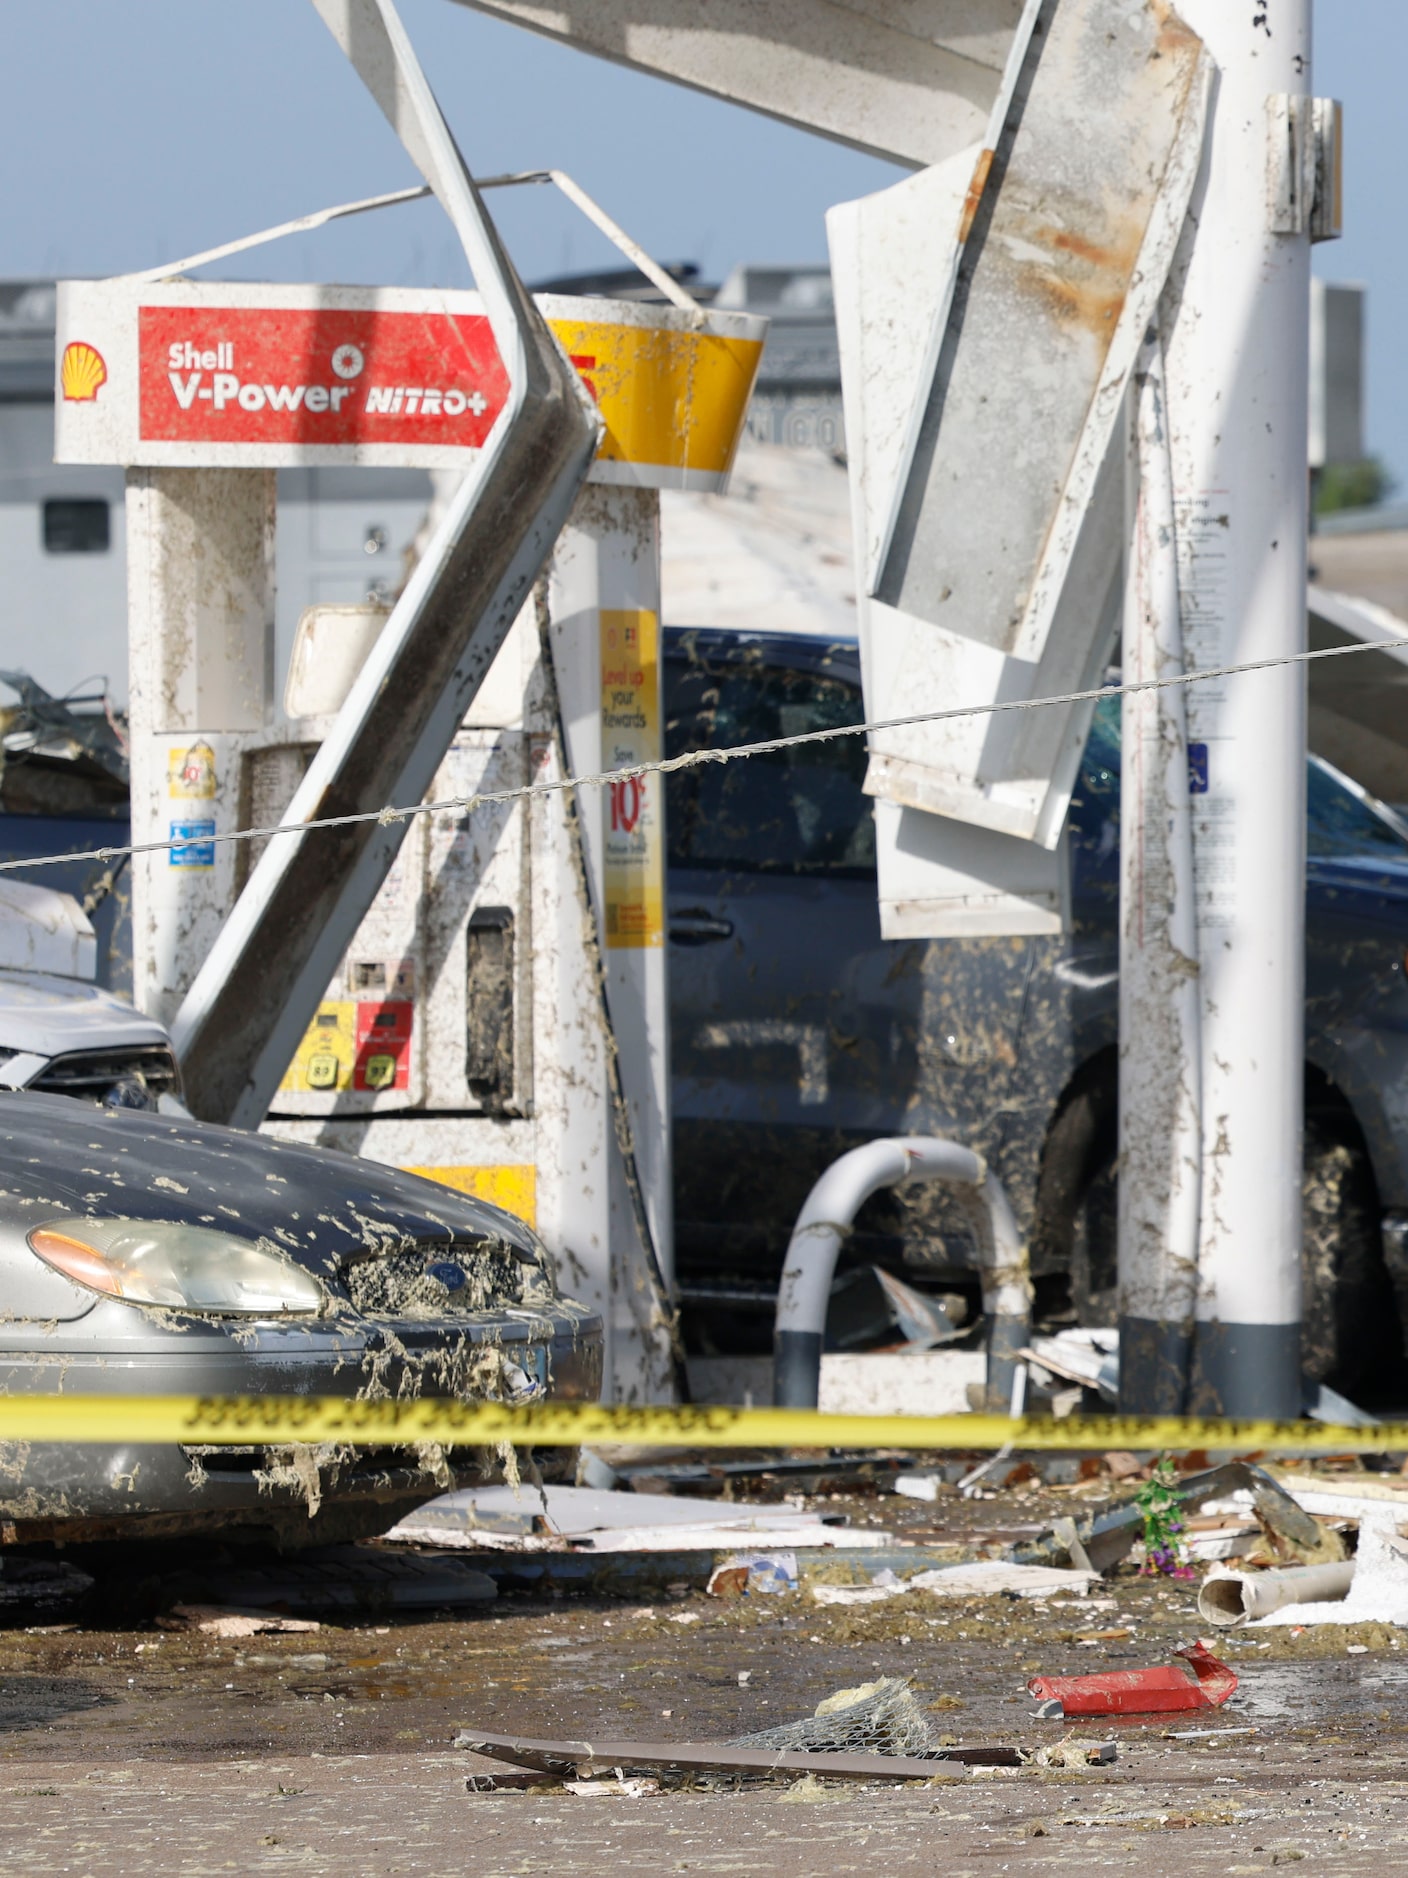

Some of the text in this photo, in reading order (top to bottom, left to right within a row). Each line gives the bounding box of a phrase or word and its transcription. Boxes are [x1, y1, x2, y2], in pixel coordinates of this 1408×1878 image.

[167, 341, 234, 371] Shell
[167, 372, 349, 414] V-Power
[611, 690, 634, 711] your
[614, 746, 634, 763] Save
